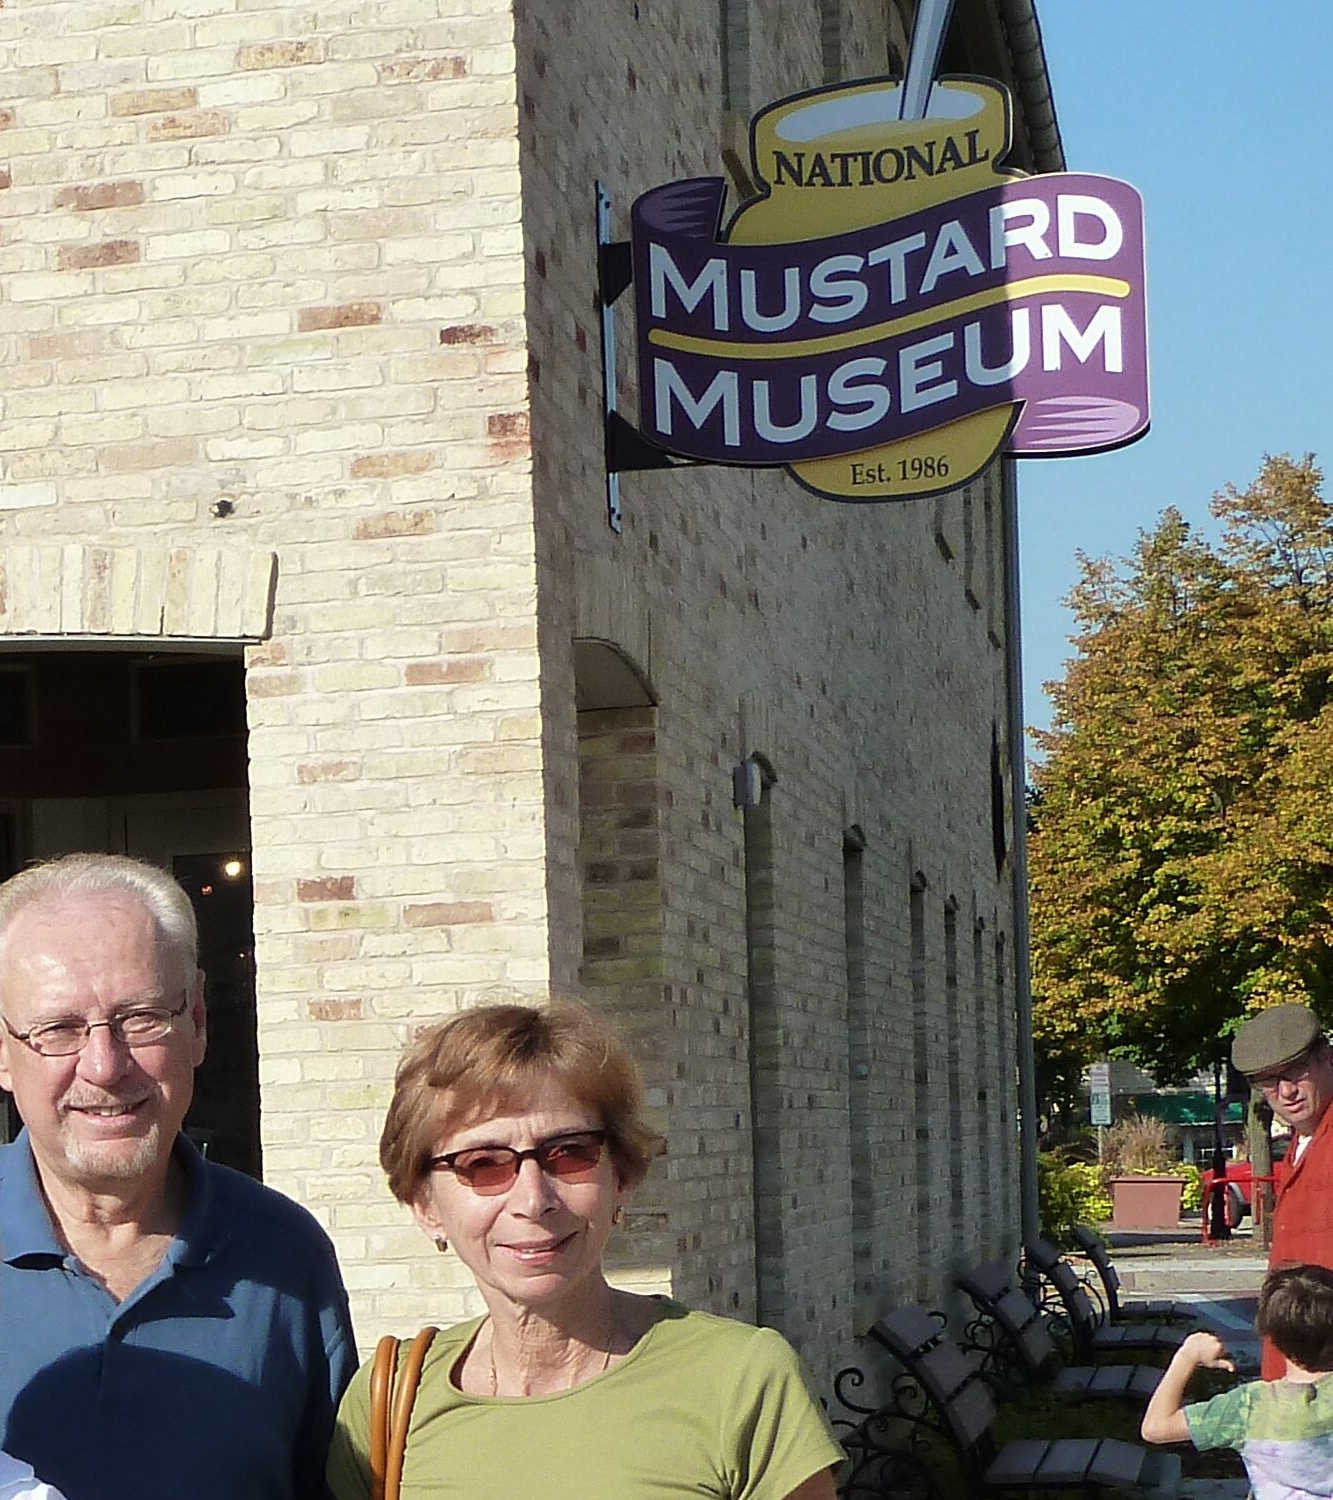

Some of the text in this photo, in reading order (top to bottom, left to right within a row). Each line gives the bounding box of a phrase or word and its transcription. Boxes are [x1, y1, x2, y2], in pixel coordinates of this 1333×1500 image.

[773, 129, 988, 188] NATIONAL
[650, 194, 1123, 333] MUSTARD
[653, 304, 1123, 447] MUSEUM
[850, 455, 949, 486] Est. 1986
